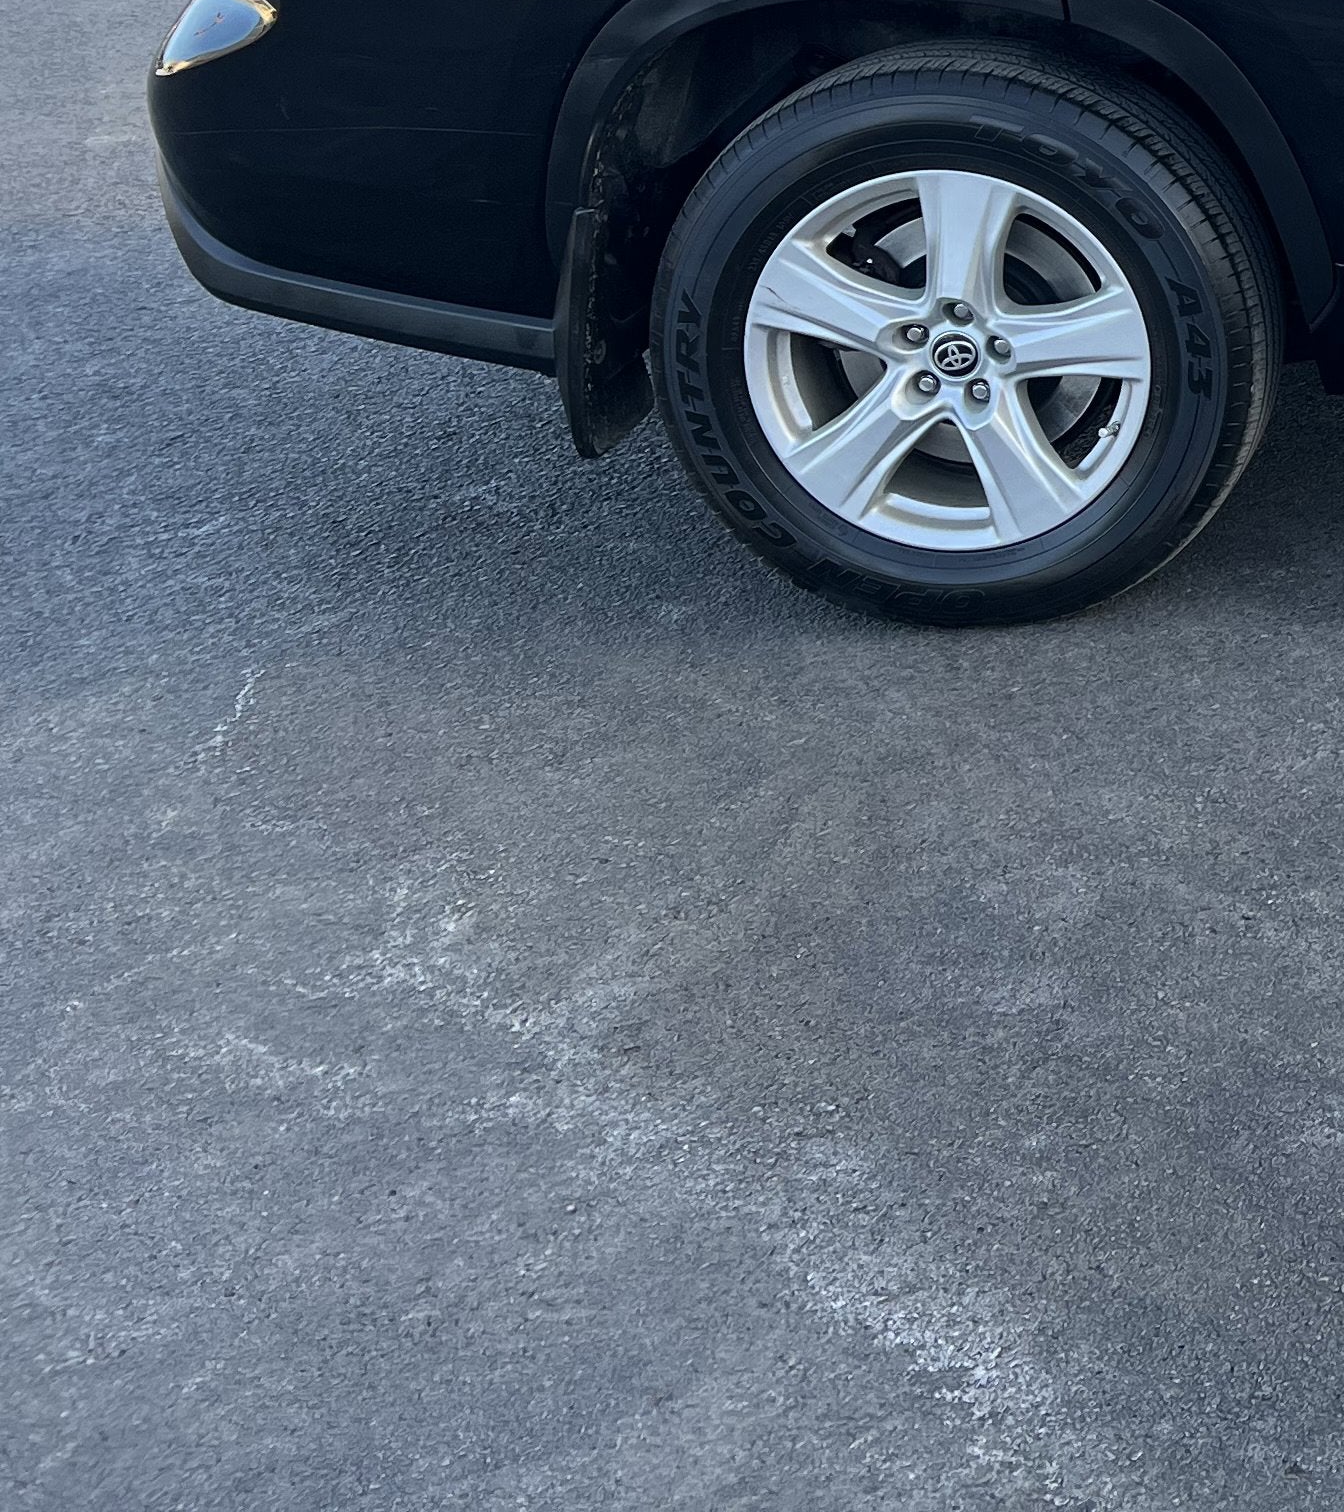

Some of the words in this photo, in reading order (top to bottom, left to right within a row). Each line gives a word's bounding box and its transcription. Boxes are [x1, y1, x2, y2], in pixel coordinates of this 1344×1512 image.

[968, 113, 1166, 240] TOYO
[1164, 276, 1213, 402] A43
[674, 287, 799, 548] COUNTRY
